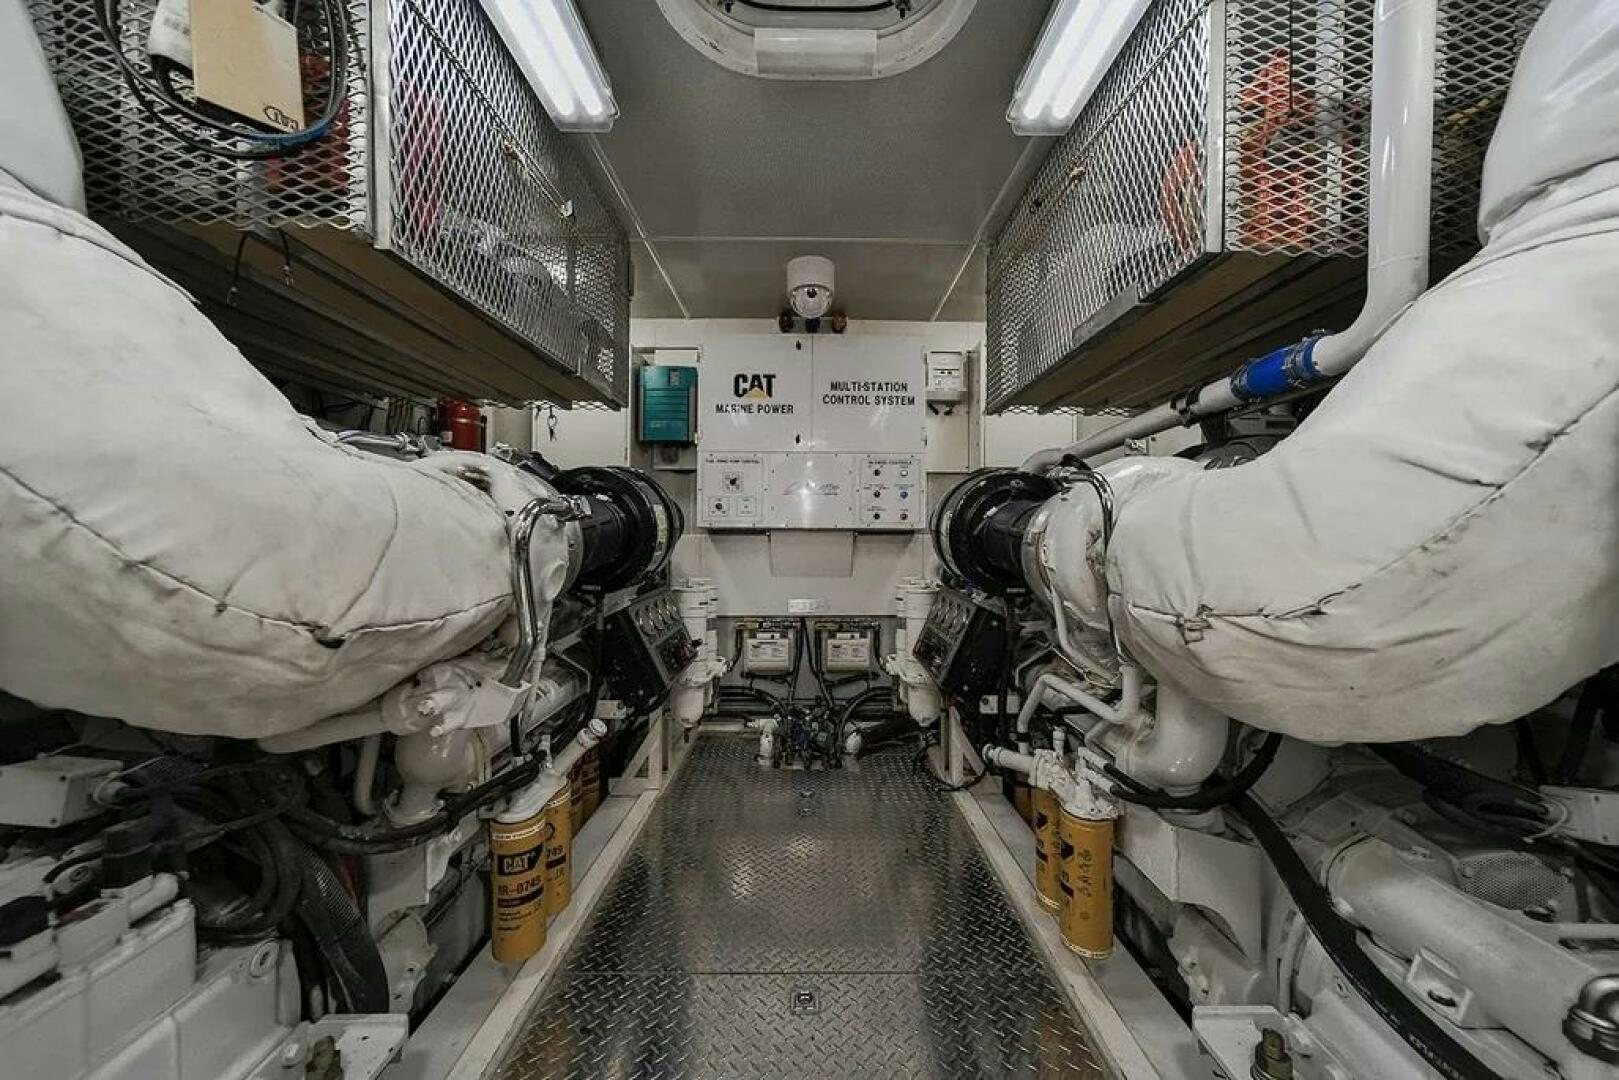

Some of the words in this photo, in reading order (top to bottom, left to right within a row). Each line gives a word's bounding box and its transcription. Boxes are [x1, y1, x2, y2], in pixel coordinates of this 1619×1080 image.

[734, 373, 776, 398] CAT
[830, 381, 907, 392] MULTI-STATION
[822, 394, 871, 405] CONTROL
[874, 395, 915, 406] SYSTEM
[715, 403, 754, 414] MARINE
[757, 404, 794, 414] POWER
[503, 855, 529, 873] CAT
